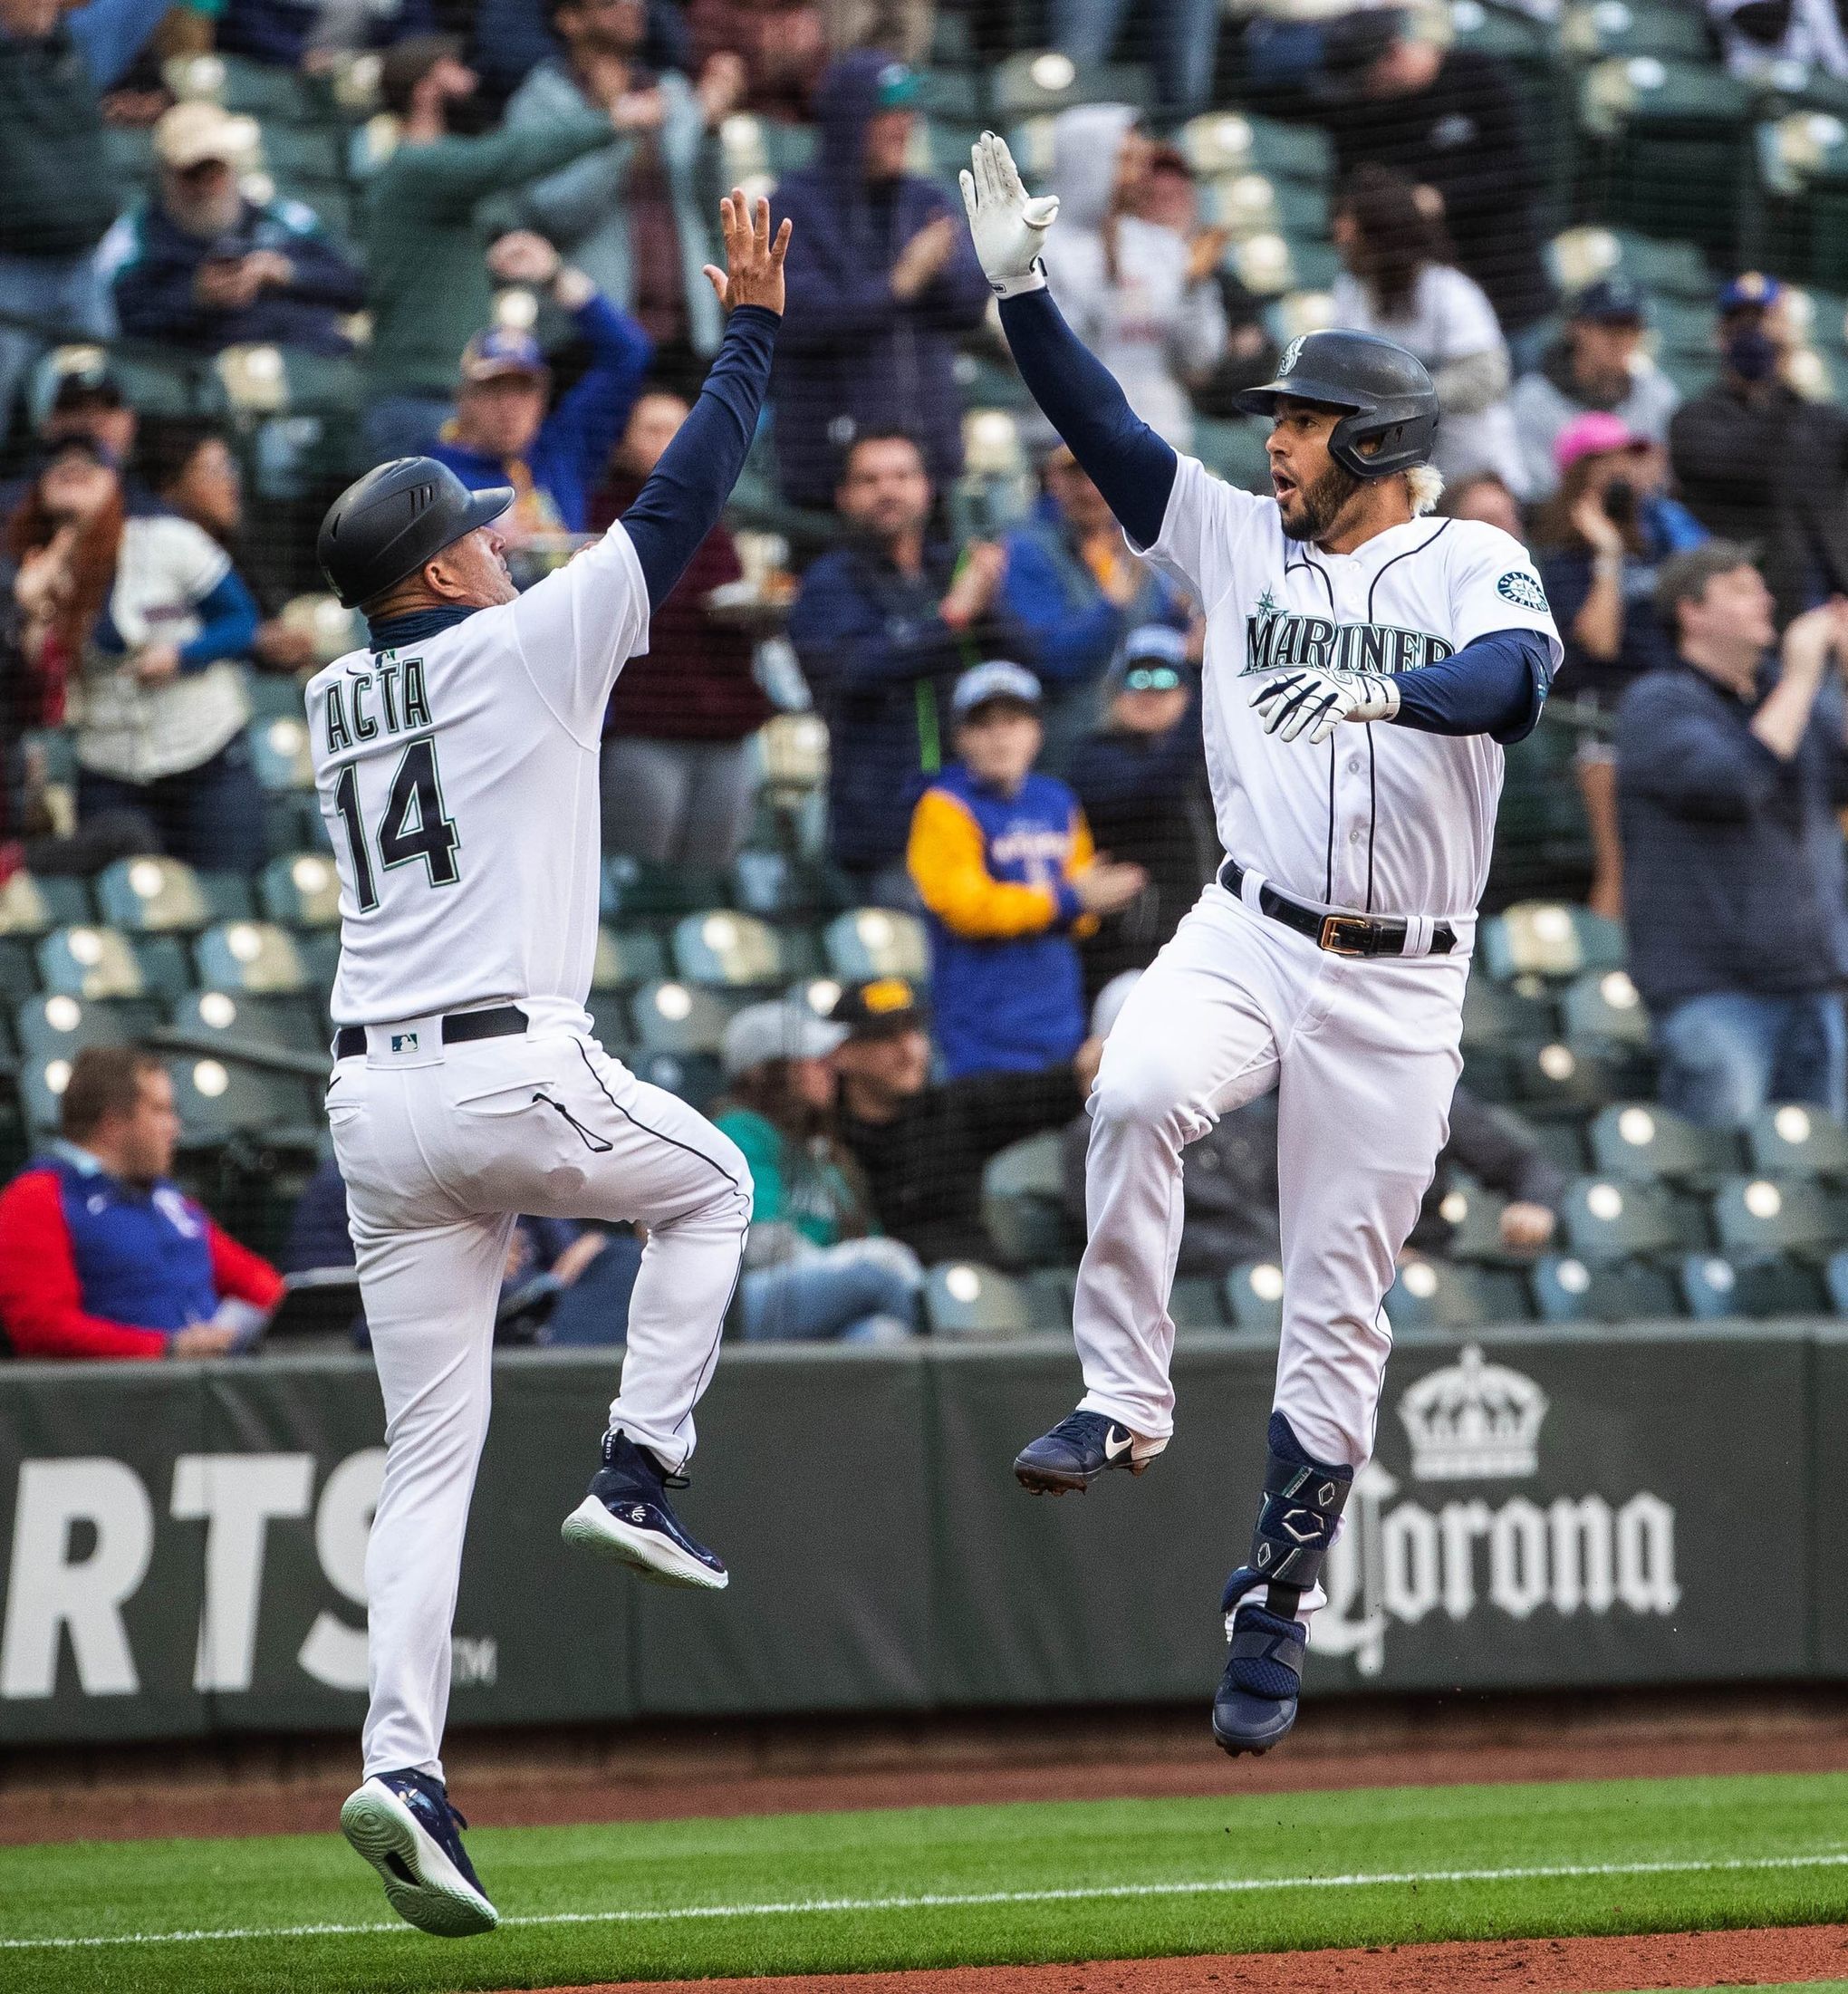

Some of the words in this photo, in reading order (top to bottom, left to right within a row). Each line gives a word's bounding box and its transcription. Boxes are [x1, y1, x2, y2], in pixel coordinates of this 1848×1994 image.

[325, 658, 432, 754] ACTA
[335, 735, 460, 914] 14
[1310, 1461, 1680, 1675] Corona
